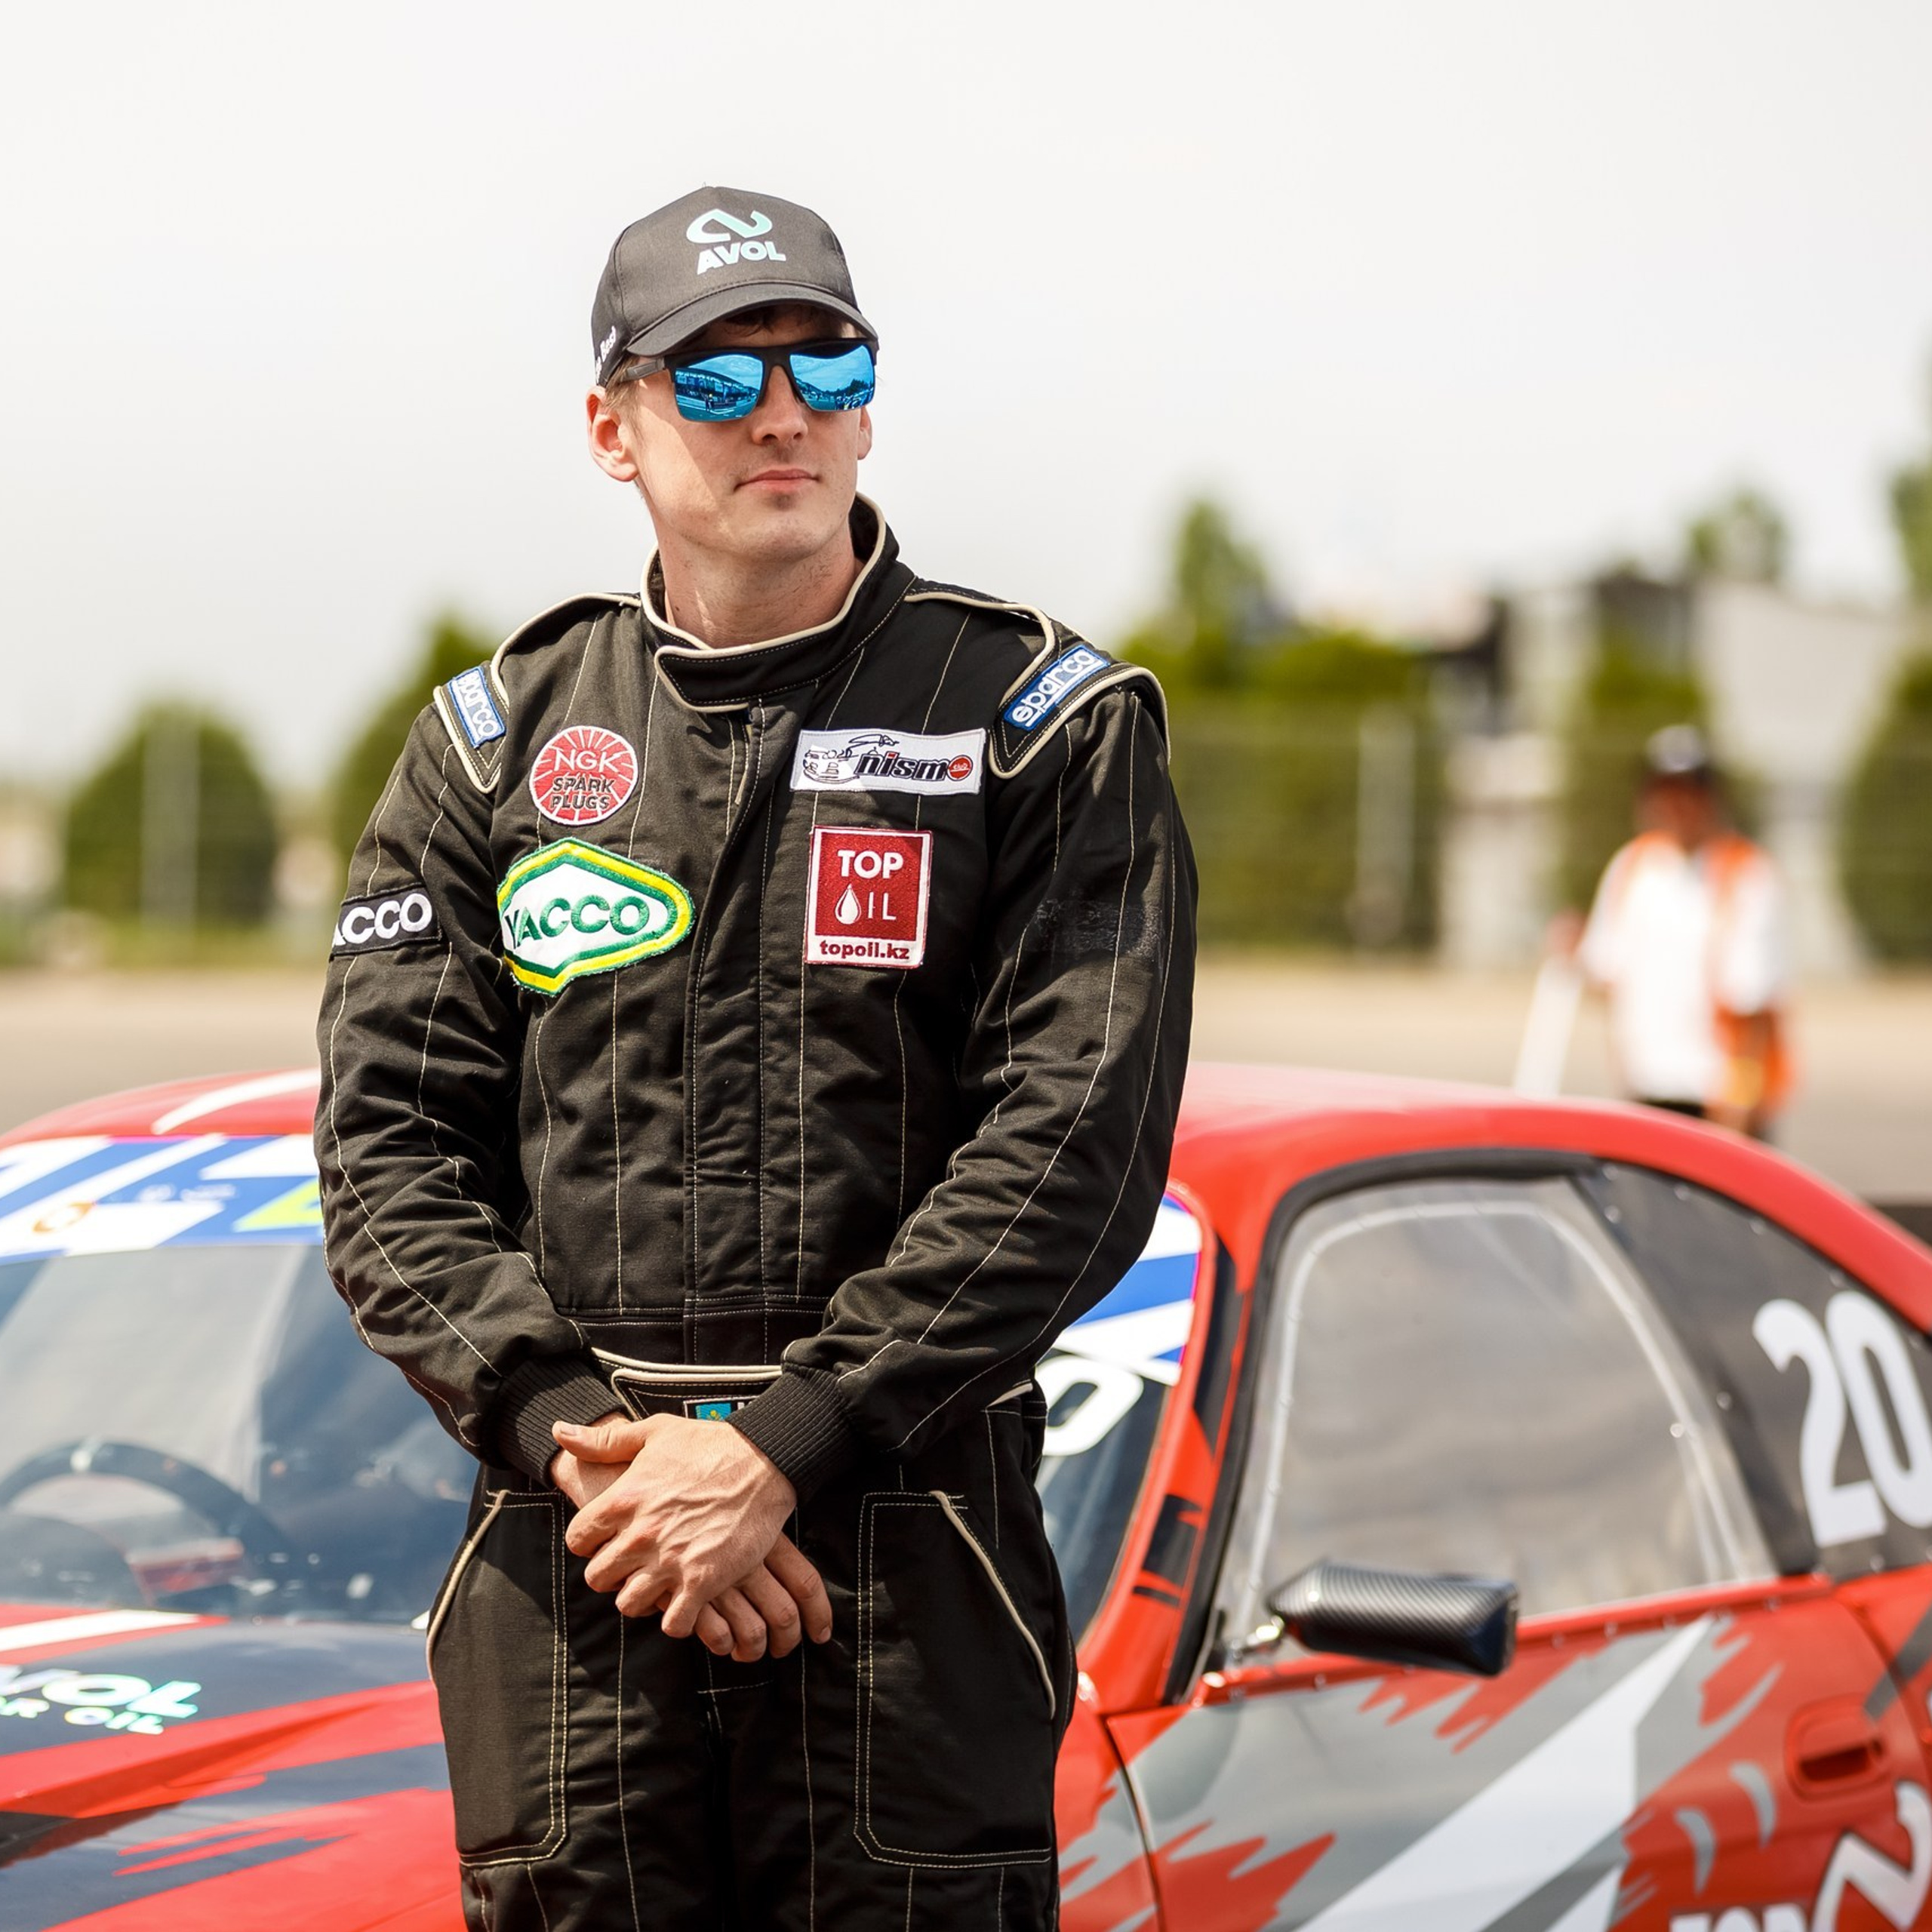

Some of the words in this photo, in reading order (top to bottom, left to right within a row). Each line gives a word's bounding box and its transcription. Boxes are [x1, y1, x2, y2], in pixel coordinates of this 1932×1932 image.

[697, 241, 786, 275] AVOL
[1011, 651, 1095, 722] sparco
[456, 670, 498, 737] sparco
[553, 749, 622, 772] NGK
[854, 751, 974, 782] nismo
[552, 777, 615, 793] SPARK
[549, 795, 611, 811] PLUGS
[837, 849, 905, 879] TOP
[504, 894, 651, 949] YACCO
[820, 940, 910, 960] topoil.kz
[1752, 1291, 1932, 1547] 20
[64, 1706, 165, 1735] OIL
